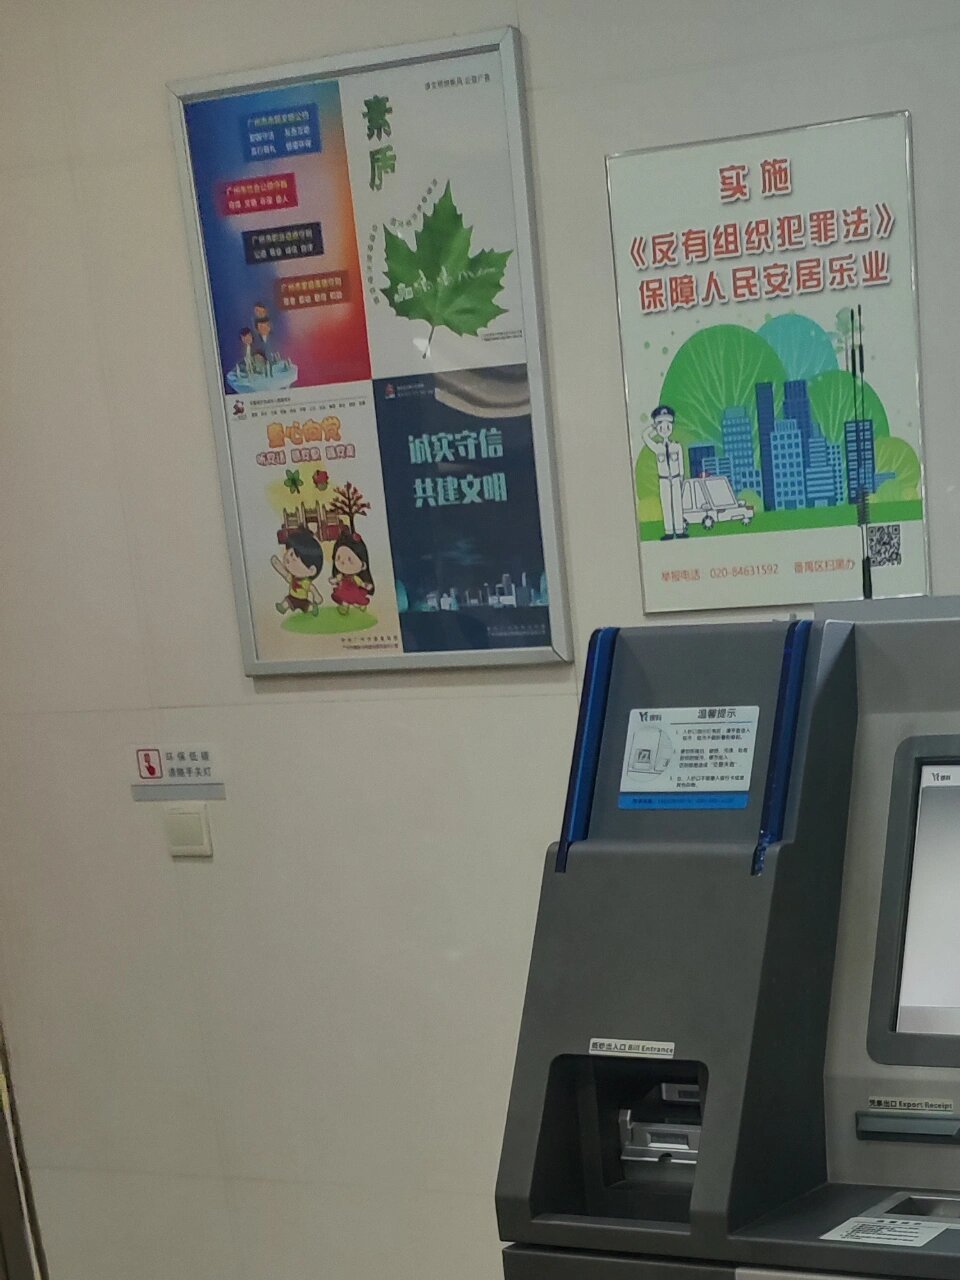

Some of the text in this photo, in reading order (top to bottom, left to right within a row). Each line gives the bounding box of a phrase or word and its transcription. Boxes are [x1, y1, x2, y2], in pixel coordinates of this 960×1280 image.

[719, 158, 793, 200] 实施
[629, 202, 896, 269] 《反有组织犯罪法》
[638, 250, 891, 313] 保障人民安居乐业
[408, 427, 503, 465] 诚实守信
[413, 473, 508, 507] 共建文明
[641, 1044, 674, 1054] Entrance
[898, 1099, 924, 1110] Export
[925, 1101, 953, 1112] Receipt
